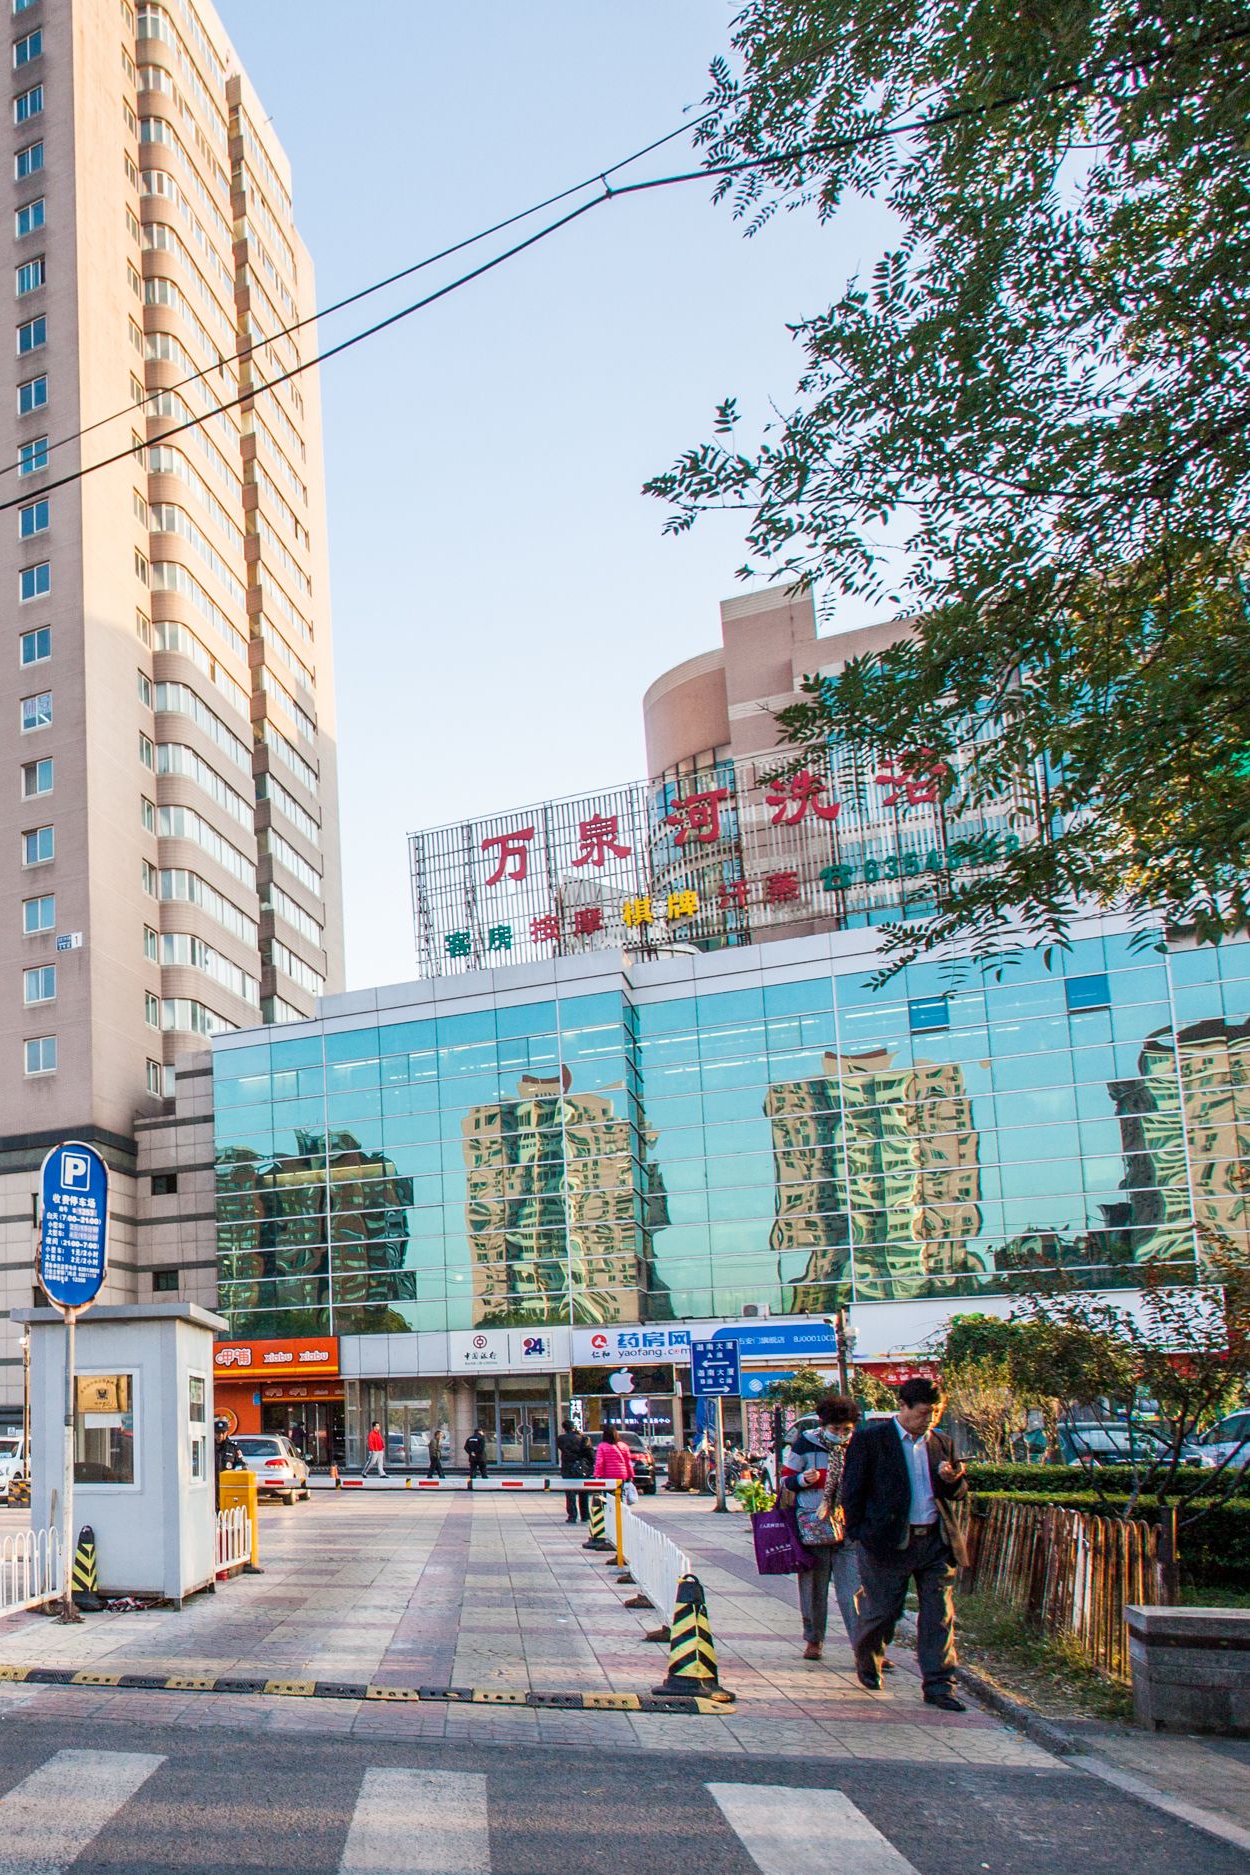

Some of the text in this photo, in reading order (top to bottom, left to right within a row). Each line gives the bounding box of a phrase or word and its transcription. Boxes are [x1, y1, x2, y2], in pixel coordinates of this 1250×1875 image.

[622, 889, 699, 928] 棋牌
[64, 1157, 87, 1185] P
[52, 1193, 96, 1208] 收费停车场
[523, 1337, 545, 1356] 24
[617, 1331, 691, 1349] 药房网
[263, 1351, 293, 1363] xiabu
[299, 1350, 329, 1362] xiabu
